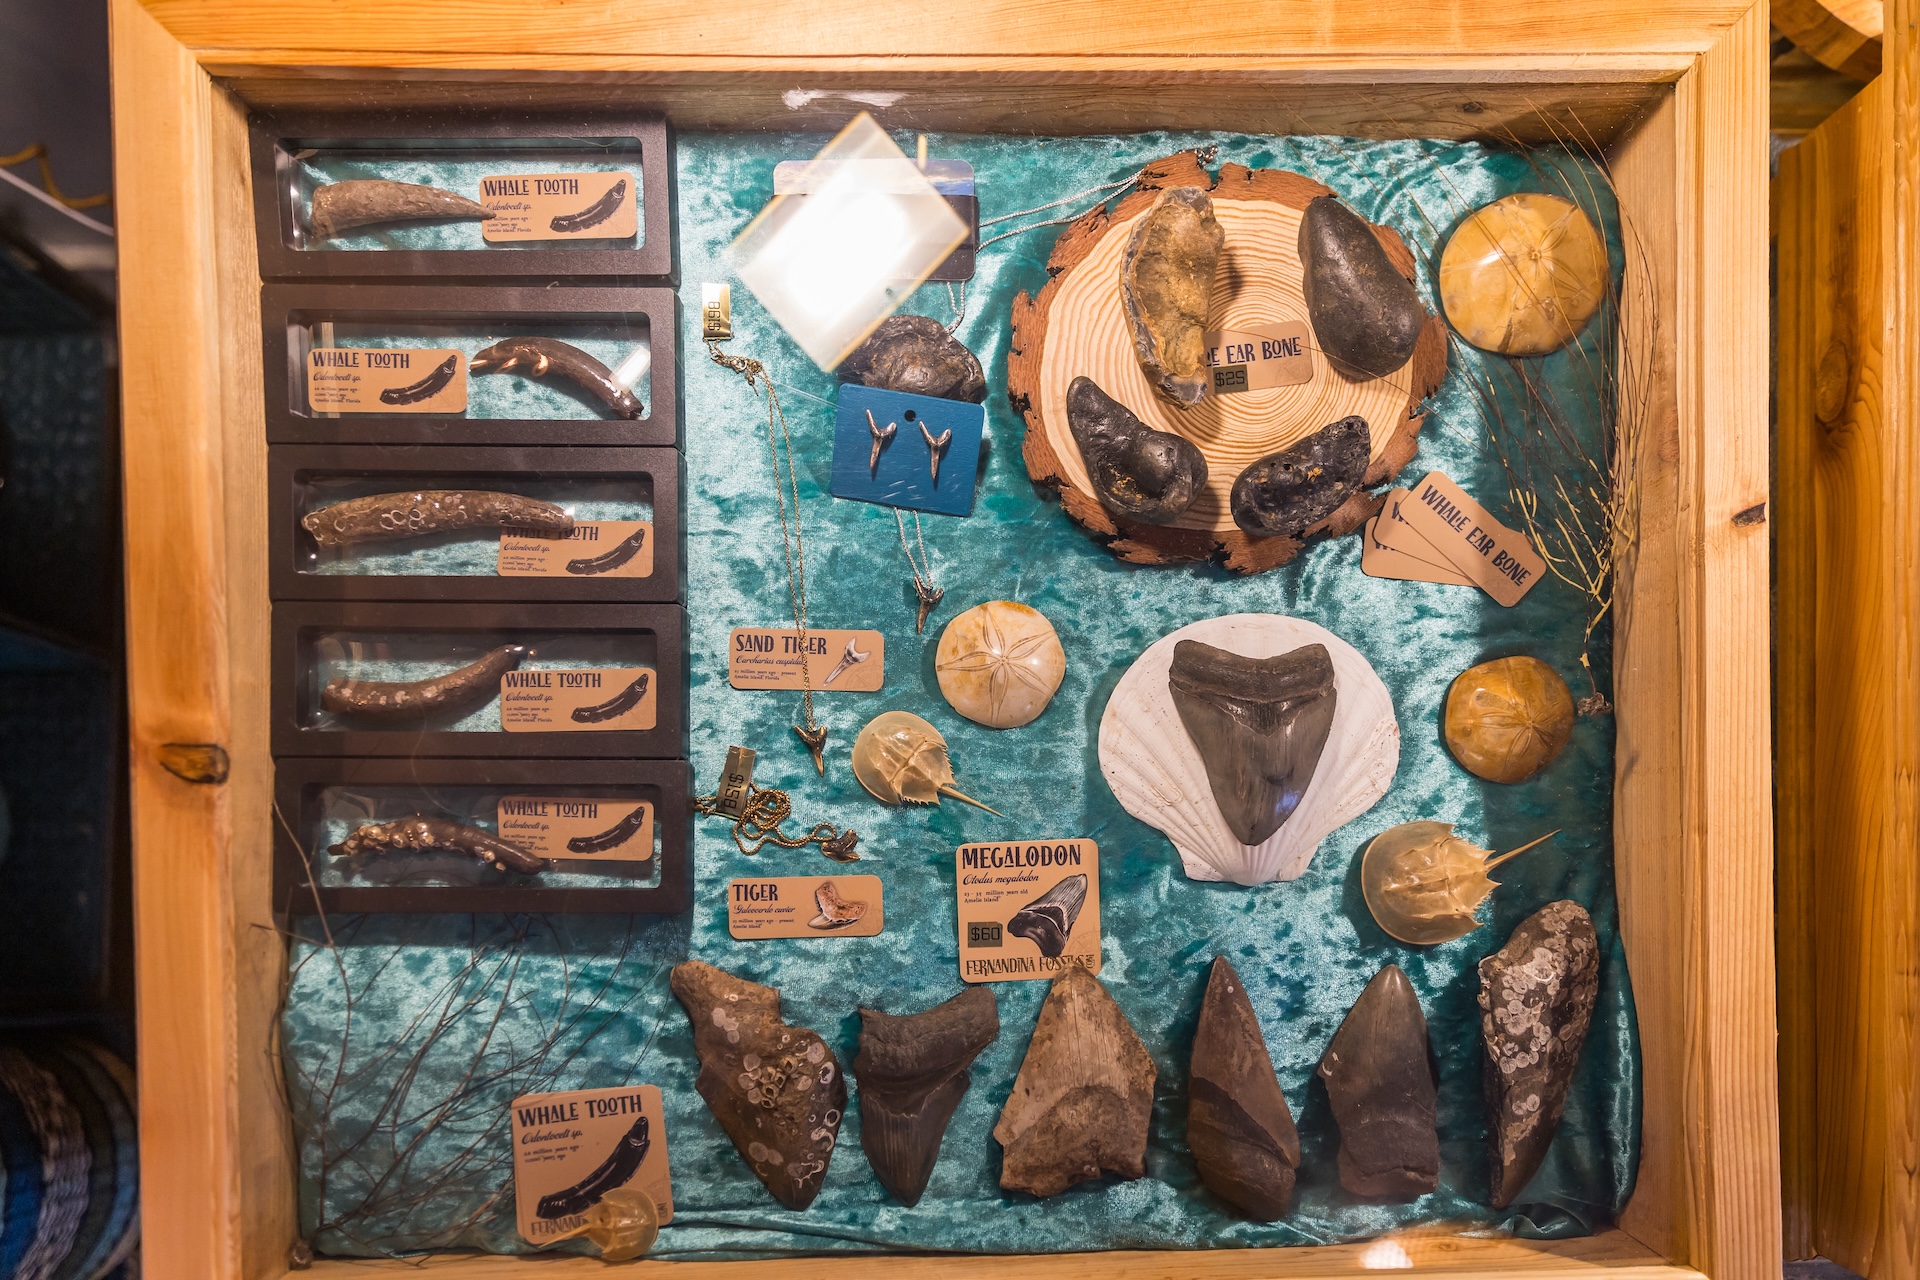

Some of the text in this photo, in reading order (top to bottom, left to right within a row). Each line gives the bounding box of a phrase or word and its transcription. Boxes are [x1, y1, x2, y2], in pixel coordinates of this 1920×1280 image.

[483, 179, 579, 197] WHALE TOOTH
[708, 301, 721, 331] $198
[313, 352, 410, 369] WHALE TOOTH
[1226, 343, 1256, 365] EAR
[1261, 337, 1302, 360] BONE
[1215, 370, 1246, 388] $25
[1420, 484, 1471, 533] WHALE
[1465, 526, 1496, 557] EAR
[1491, 549, 1532, 587] BONE
[736, 634, 775, 653] SAND
[506, 673, 602, 689] WHALE TOOTH
[723, 773, 745, 809] $158
[502, 800, 598, 819] WHALE TOOTH
[962, 844, 1081, 869] MEGALODON
[994, 869, 1039, 885] megalodon
[733, 884, 779, 902] TIGER
[774, 906, 796, 914] cuvier
[971, 926, 1001, 942] $60
[966, 954, 1085, 977] FERNANDINA FOSSS
[518, 1094, 642, 1128] WHALE TOOTH
[571, 1130, 583, 1141] sp.
[530, 1215, 588, 1236] FERNAN
